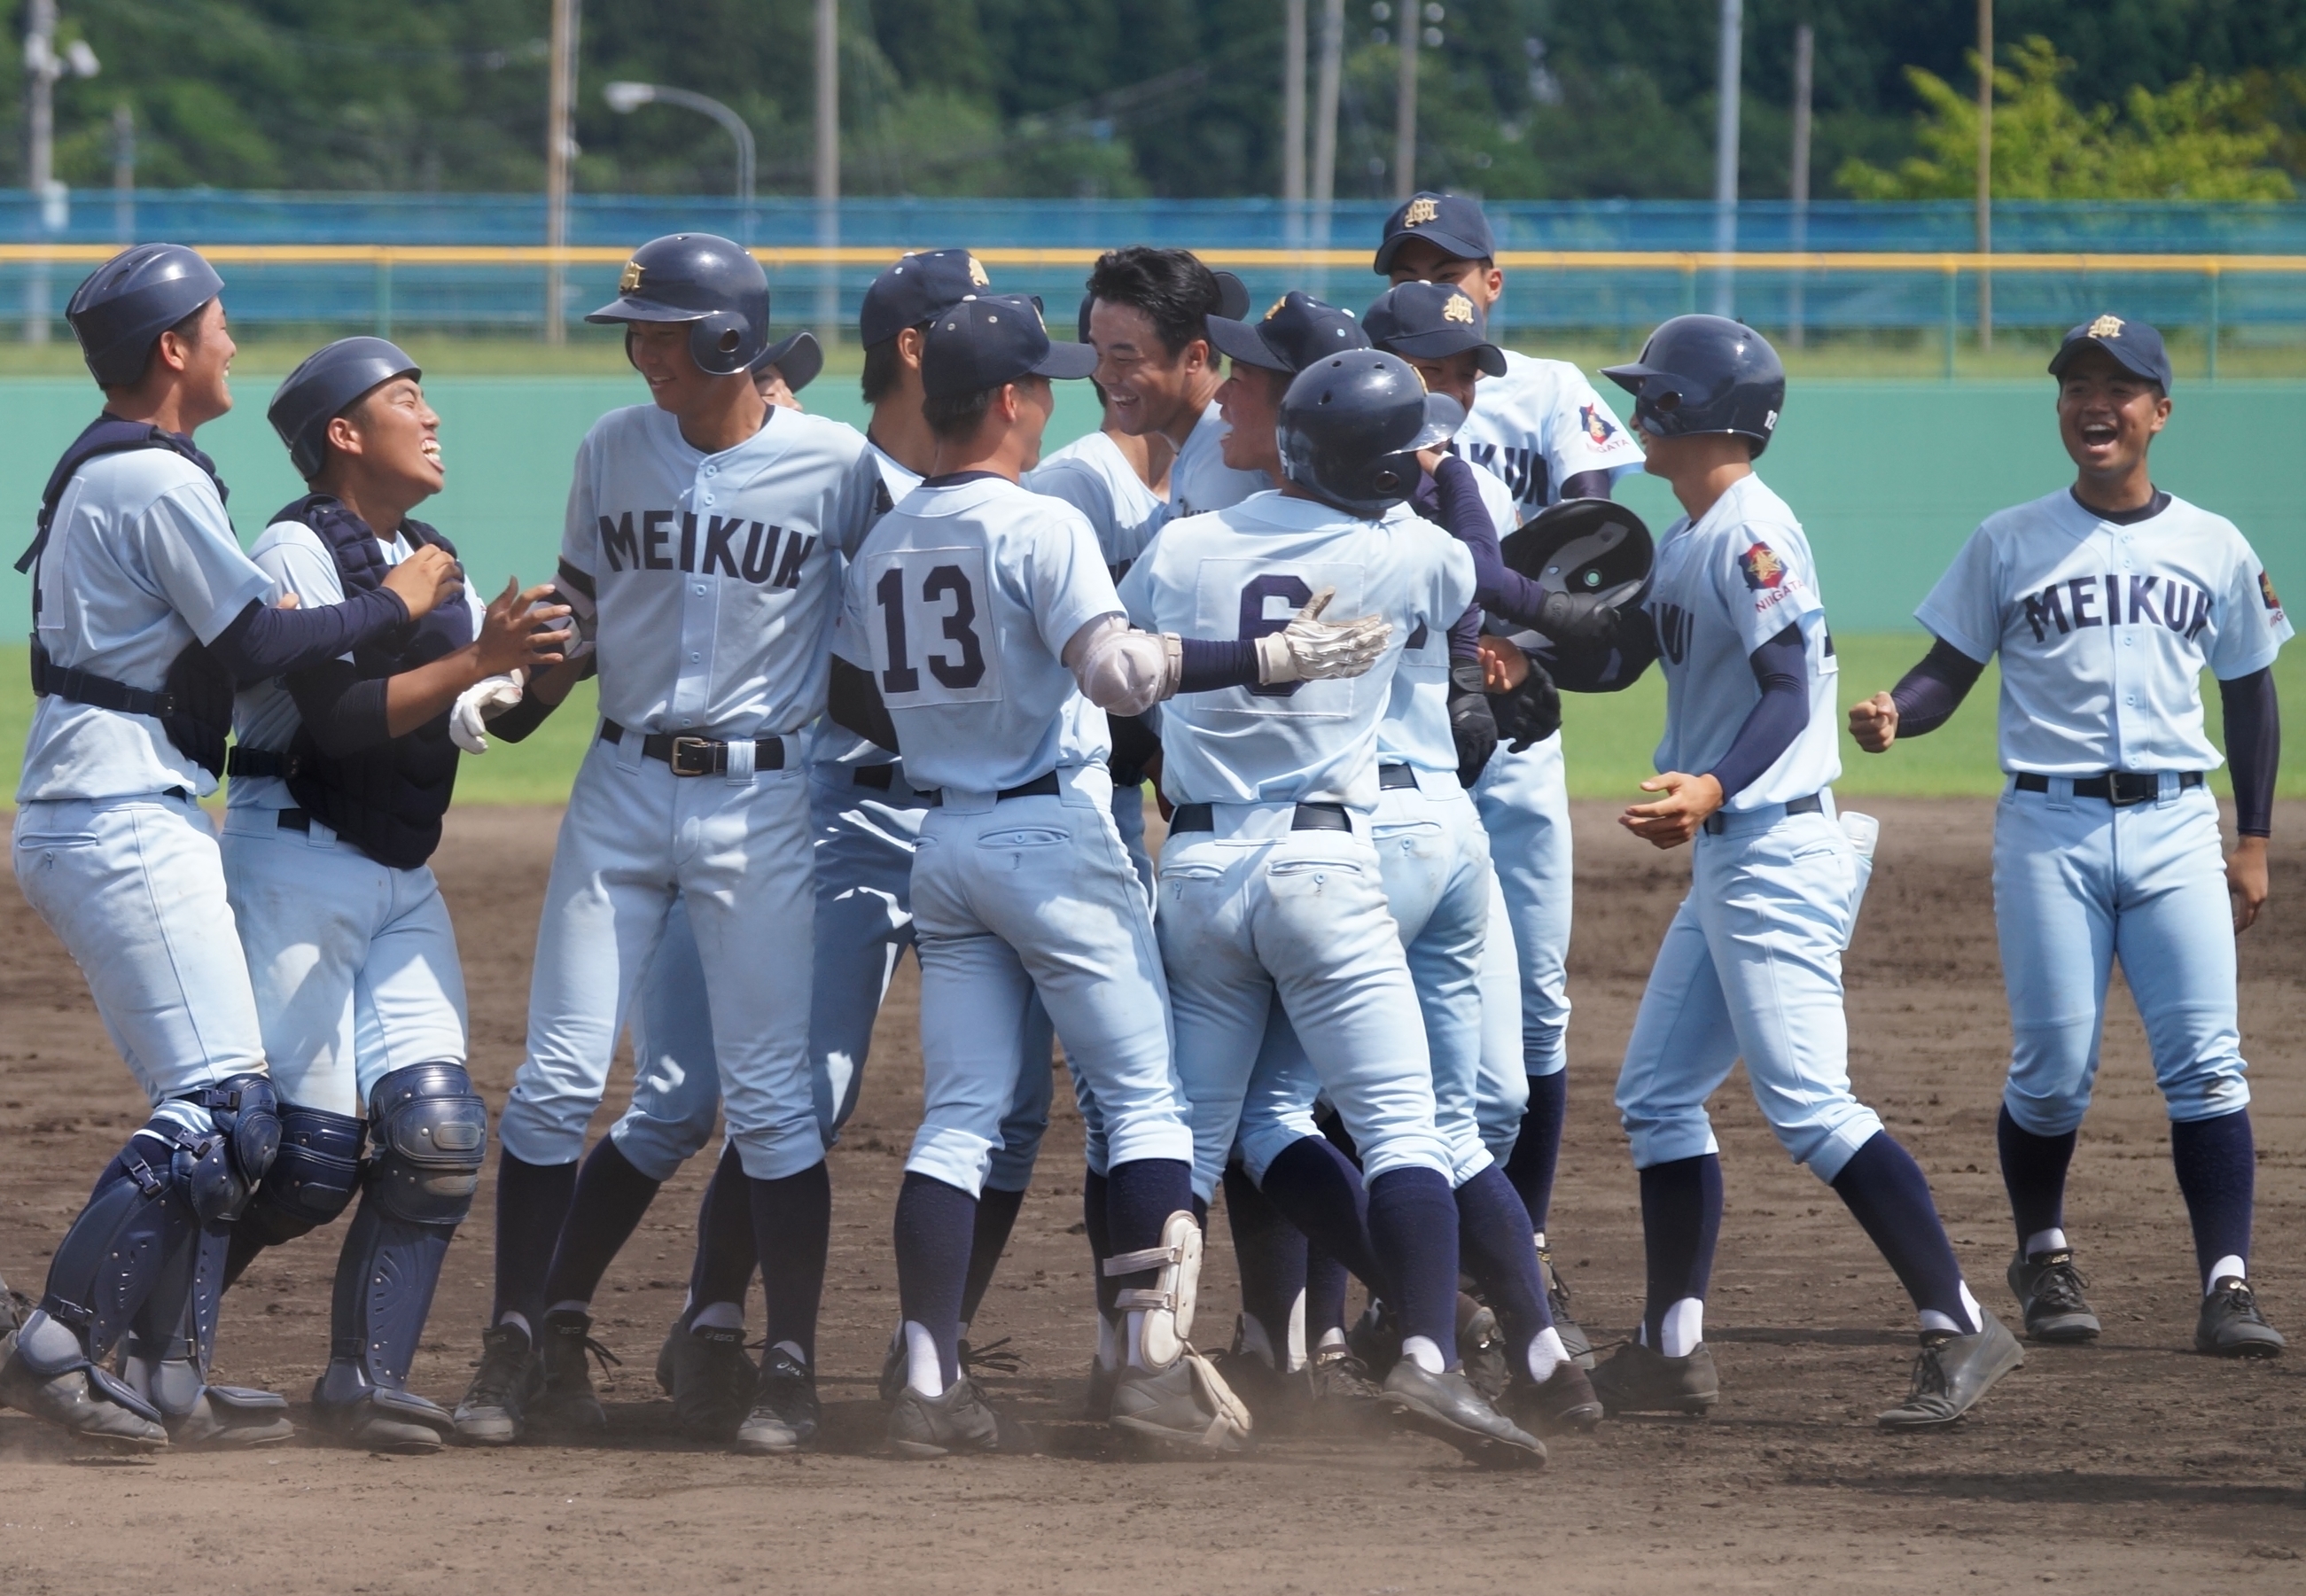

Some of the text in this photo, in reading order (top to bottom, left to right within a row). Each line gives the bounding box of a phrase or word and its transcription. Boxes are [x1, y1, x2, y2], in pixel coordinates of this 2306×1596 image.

[1765, 409, 1778, 431] 12
[598, 510, 817, 590] MEIKUN
[876, 564, 986, 694] 13
[1239, 573, 1314, 697] 6
